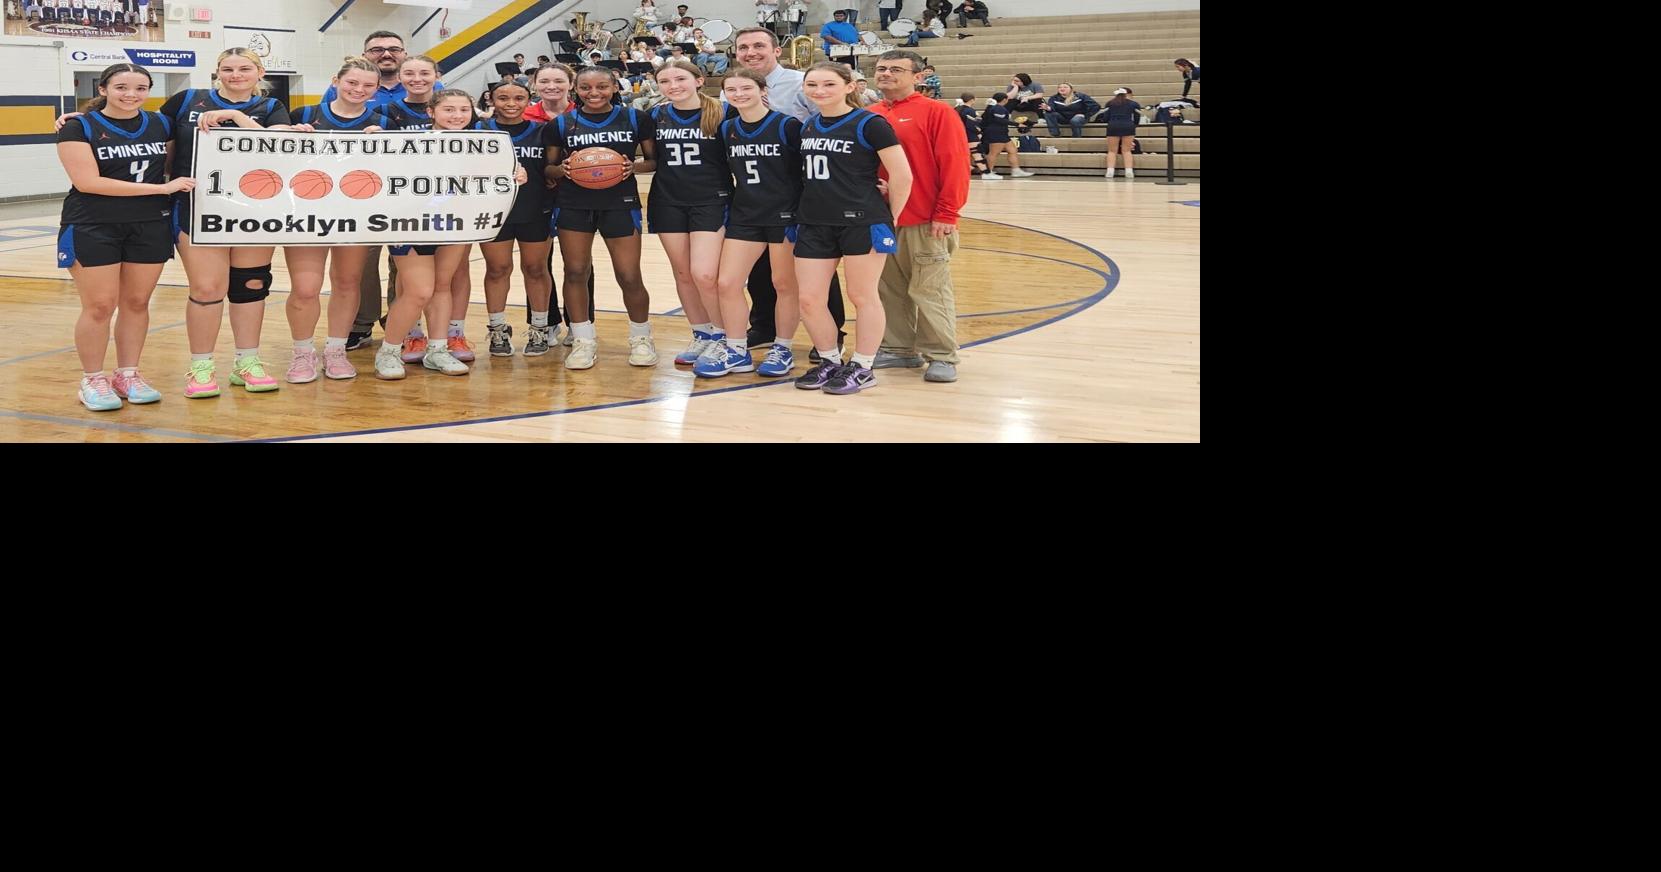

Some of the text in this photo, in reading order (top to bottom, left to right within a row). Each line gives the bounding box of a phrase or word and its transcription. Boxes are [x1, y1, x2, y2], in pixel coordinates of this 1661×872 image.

[217, 136, 500, 155] CONGRATULATIONS
[567, 131, 633, 148] EMINENCE
[800, 138, 854, 154] MINENCE
[514, 147, 544, 159] ENCE
[665, 143, 702, 166] 32
[130, 160, 149, 183] 4
[745, 160, 760, 184] 5
[805, 154, 830, 180] 10
[386, 175, 511, 196] POINTS
[201, 211, 503, 237] Brooklyn Smith #1
